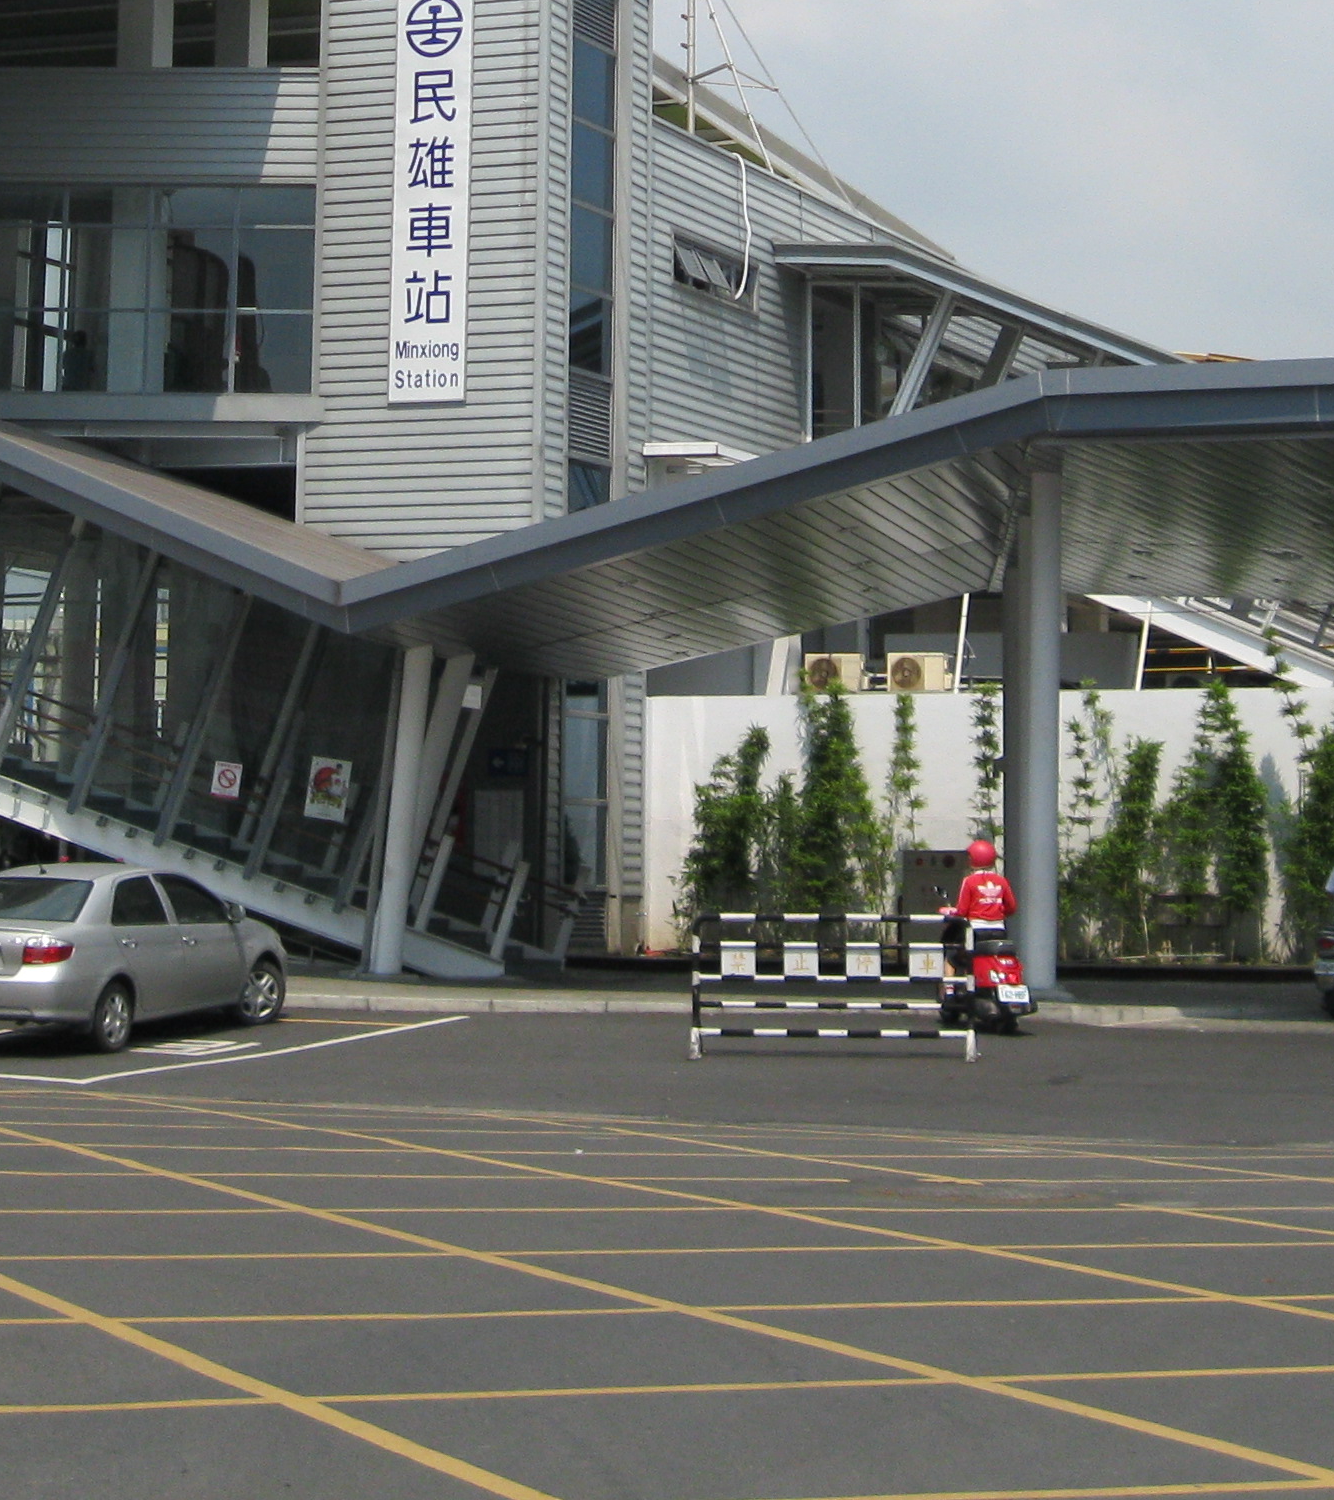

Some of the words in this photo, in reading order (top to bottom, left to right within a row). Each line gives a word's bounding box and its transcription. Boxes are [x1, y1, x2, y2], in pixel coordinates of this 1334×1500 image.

[404, 68, 458, 324] 民雄車站
[395, 340, 459, 361] Minxiong
[395, 369, 459, 389] Station
